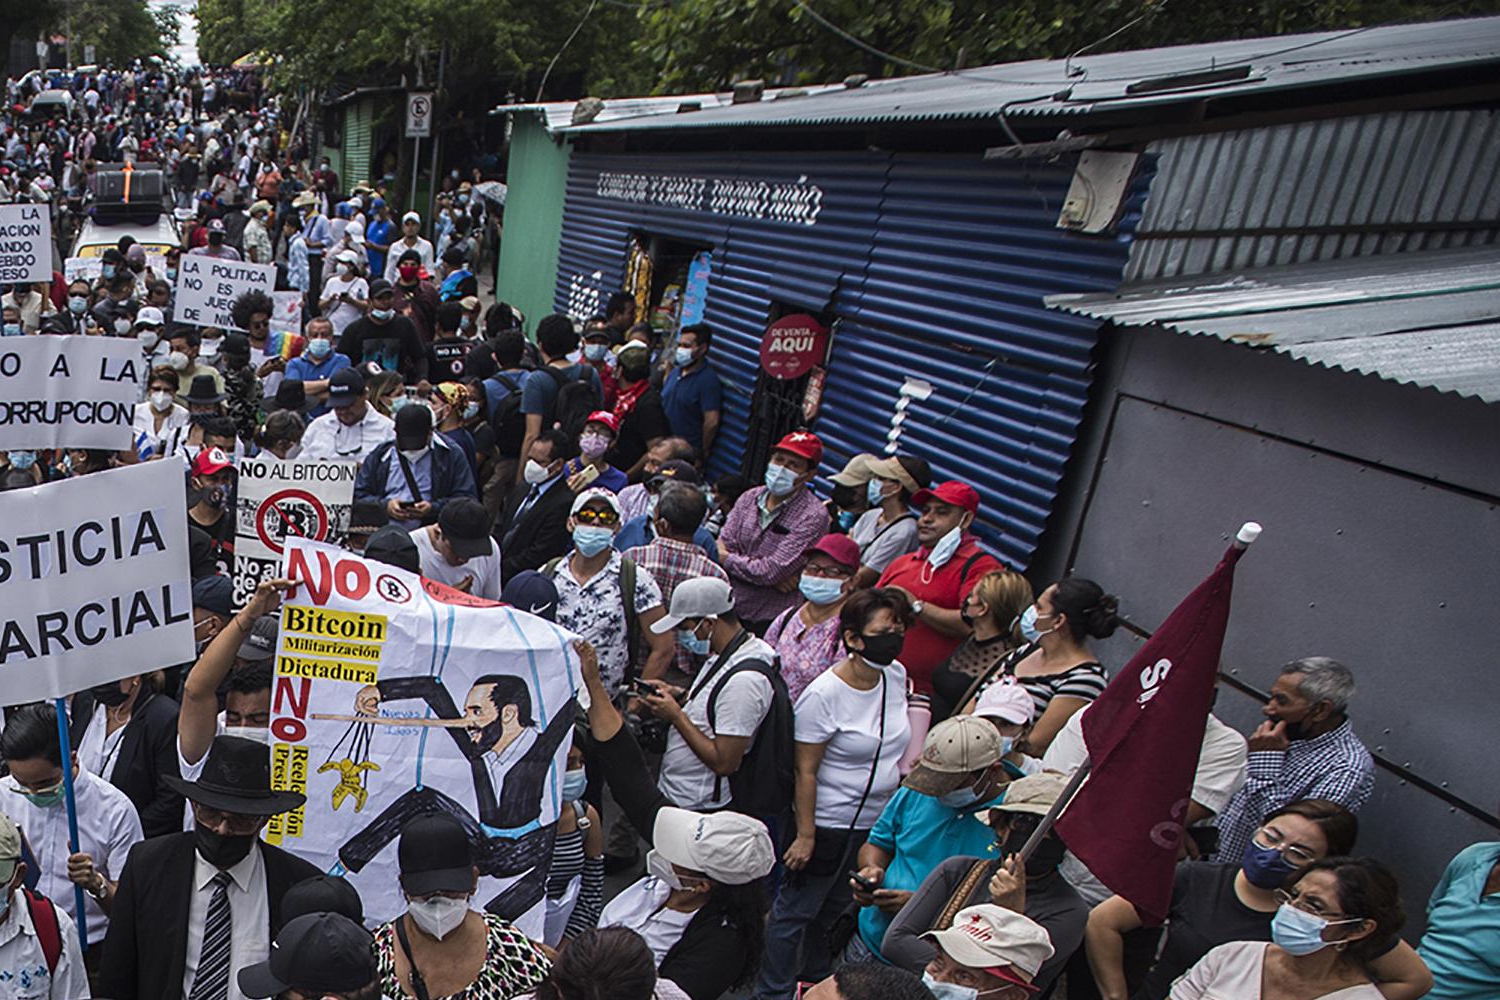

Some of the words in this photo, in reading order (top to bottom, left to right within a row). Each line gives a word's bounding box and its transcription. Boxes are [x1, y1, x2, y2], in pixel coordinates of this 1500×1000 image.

[21, 208, 40, 220] LA
[183, 261, 200, 274] LA
[211, 264, 267, 284] POLITICA
[184, 278, 203, 291] NO
[217, 283, 233, 295] ES
[184, 308, 200, 321] DE
[771, 327, 783, 337] DE
[783, 328, 810, 337] VENTA
[49, 354, 70, 378] A
[100, 357, 139, 383] LA
[239, 461, 267, 479] NO
[271, 463, 292, 480] AL
[292, 464, 355, 481] BITCOIN
[234, 556, 260, 575] No
[232, 573, 256, 591] de
[286, 606, 383, 640] Bitcoin
[285, 637, 380, 659] Militarización
[280, 656, 376, 683] Dictadura
